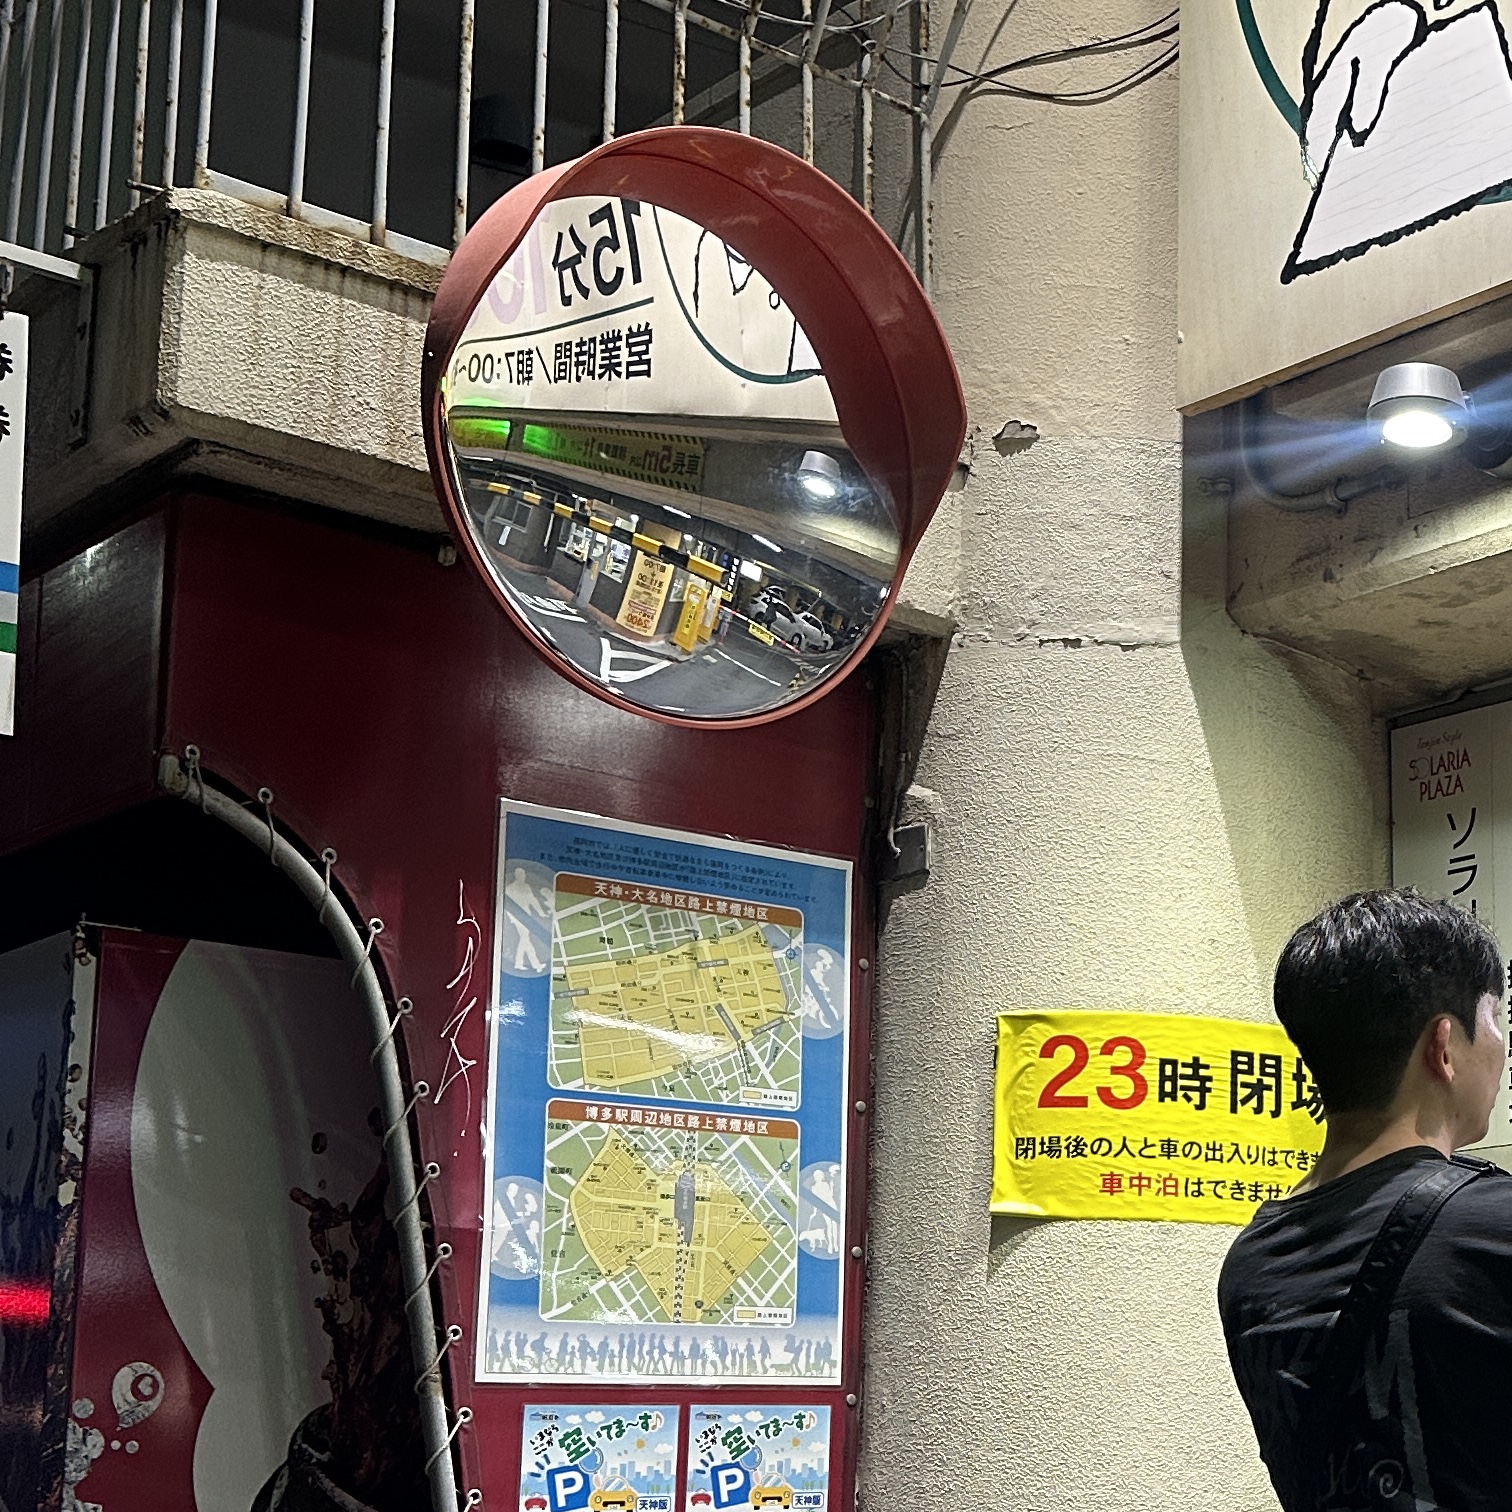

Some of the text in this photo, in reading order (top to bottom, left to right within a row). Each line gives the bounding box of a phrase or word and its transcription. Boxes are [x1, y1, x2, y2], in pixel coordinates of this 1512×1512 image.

[1408, 747, 1472, 781] SOLARIA
[1419, 774, 1465, 803] PLAZA
[1446, 807, 1478, 917] ソラ
